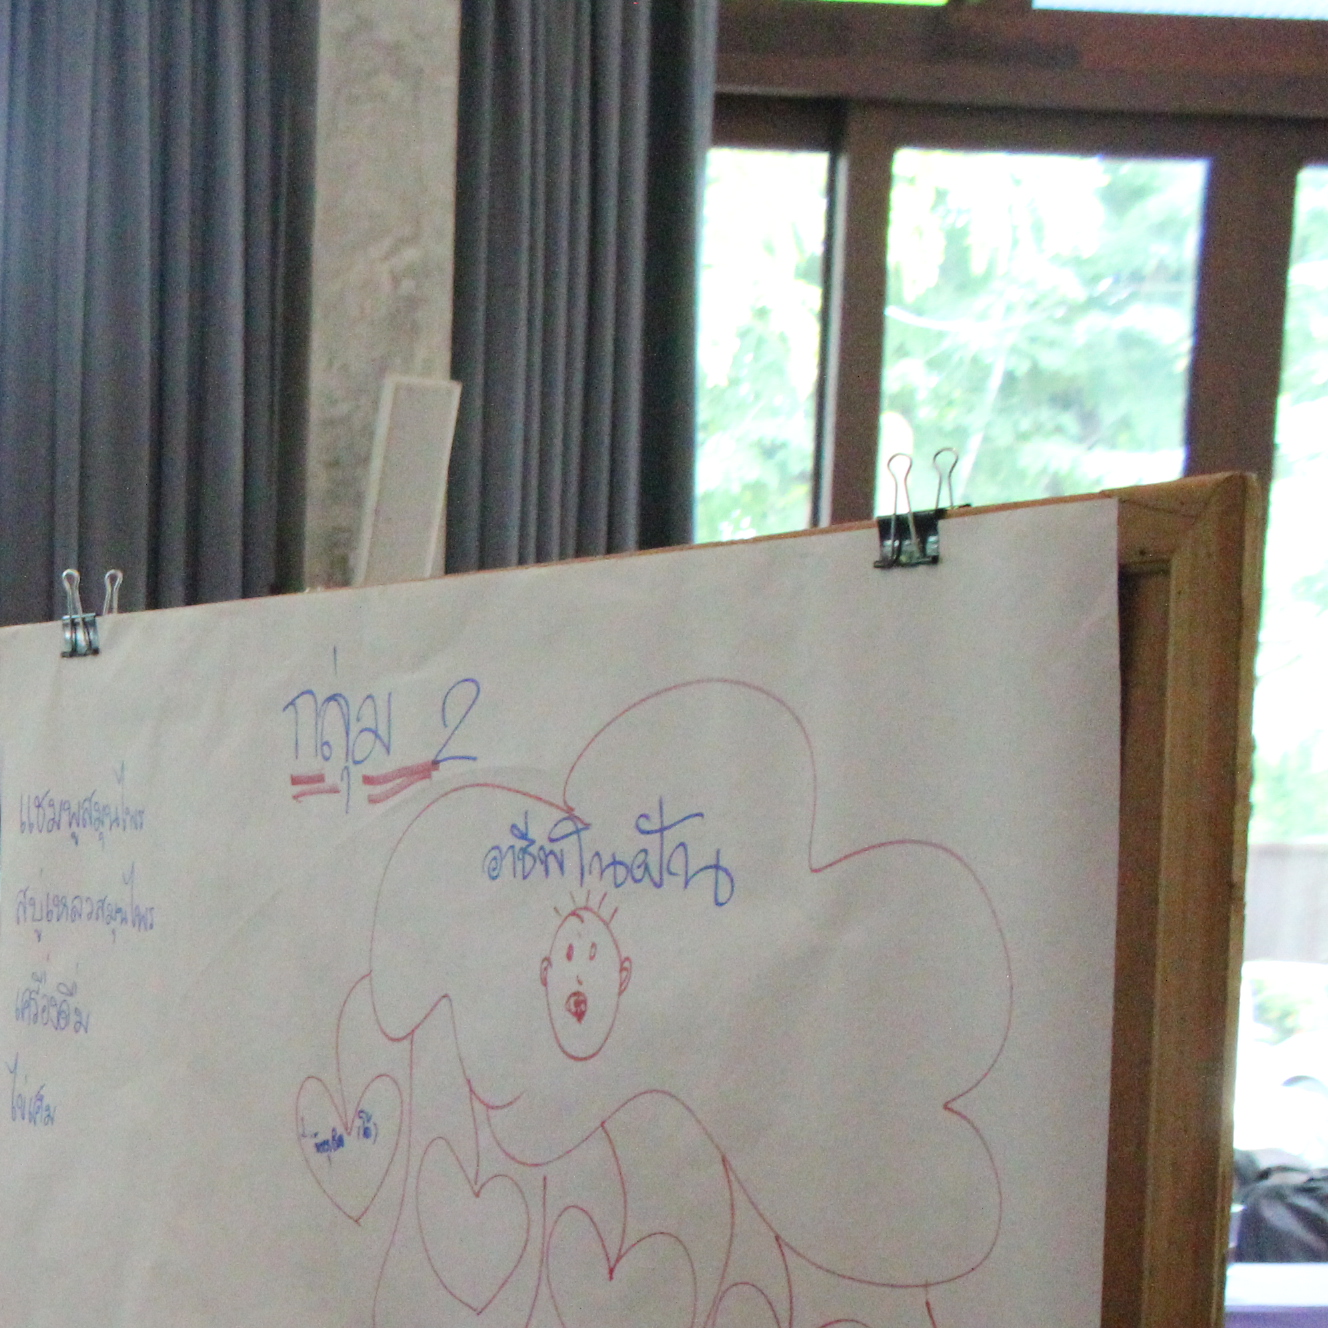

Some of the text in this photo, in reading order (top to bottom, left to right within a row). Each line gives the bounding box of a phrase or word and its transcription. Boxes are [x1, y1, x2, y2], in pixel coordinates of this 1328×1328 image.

[282, 645, 481, 814] กลุ่ม 2
[482, 795, 735, 907] อาชีพในฝัน
